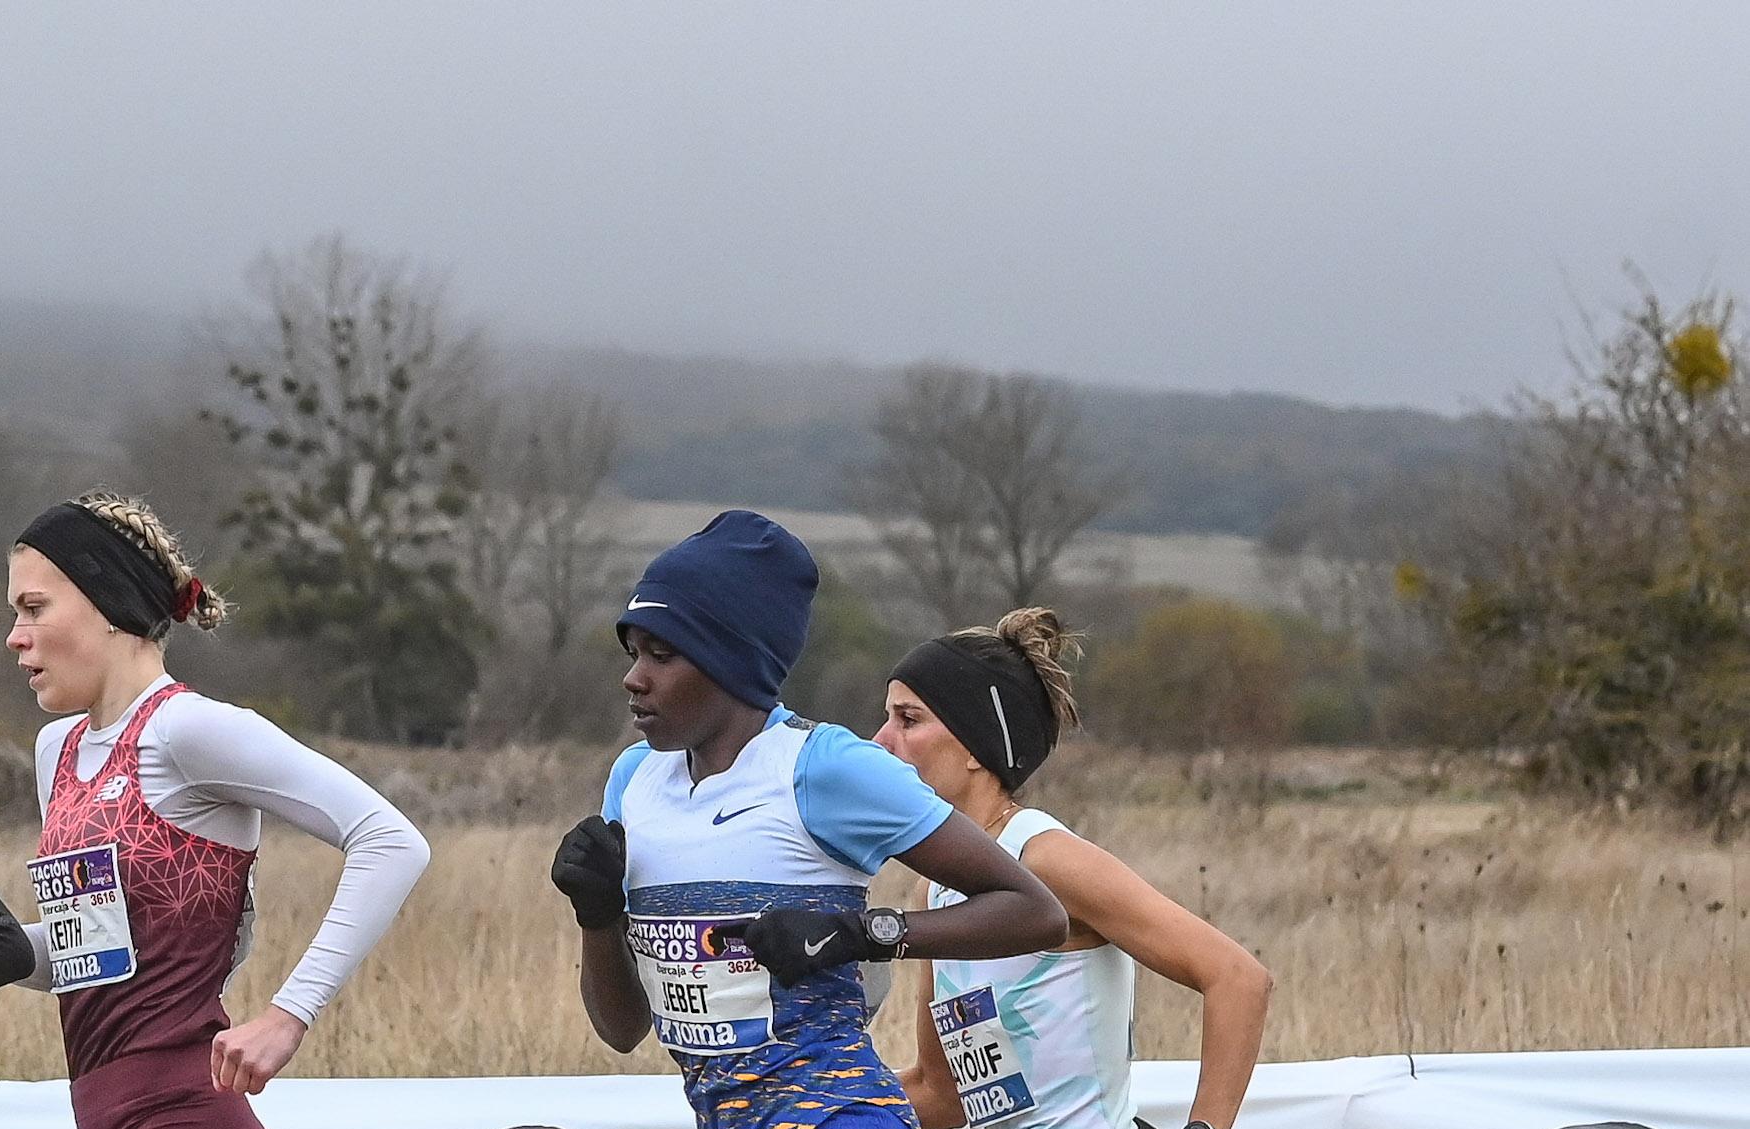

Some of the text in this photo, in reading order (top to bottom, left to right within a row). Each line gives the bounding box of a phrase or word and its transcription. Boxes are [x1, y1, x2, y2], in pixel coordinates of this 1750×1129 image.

[91, 891, 116, 906] 3616
[728, 960, 760, 974] 3622
[662, 982, 708, 1014] JEBET
[961, 1085, 1014, 1123] oma
